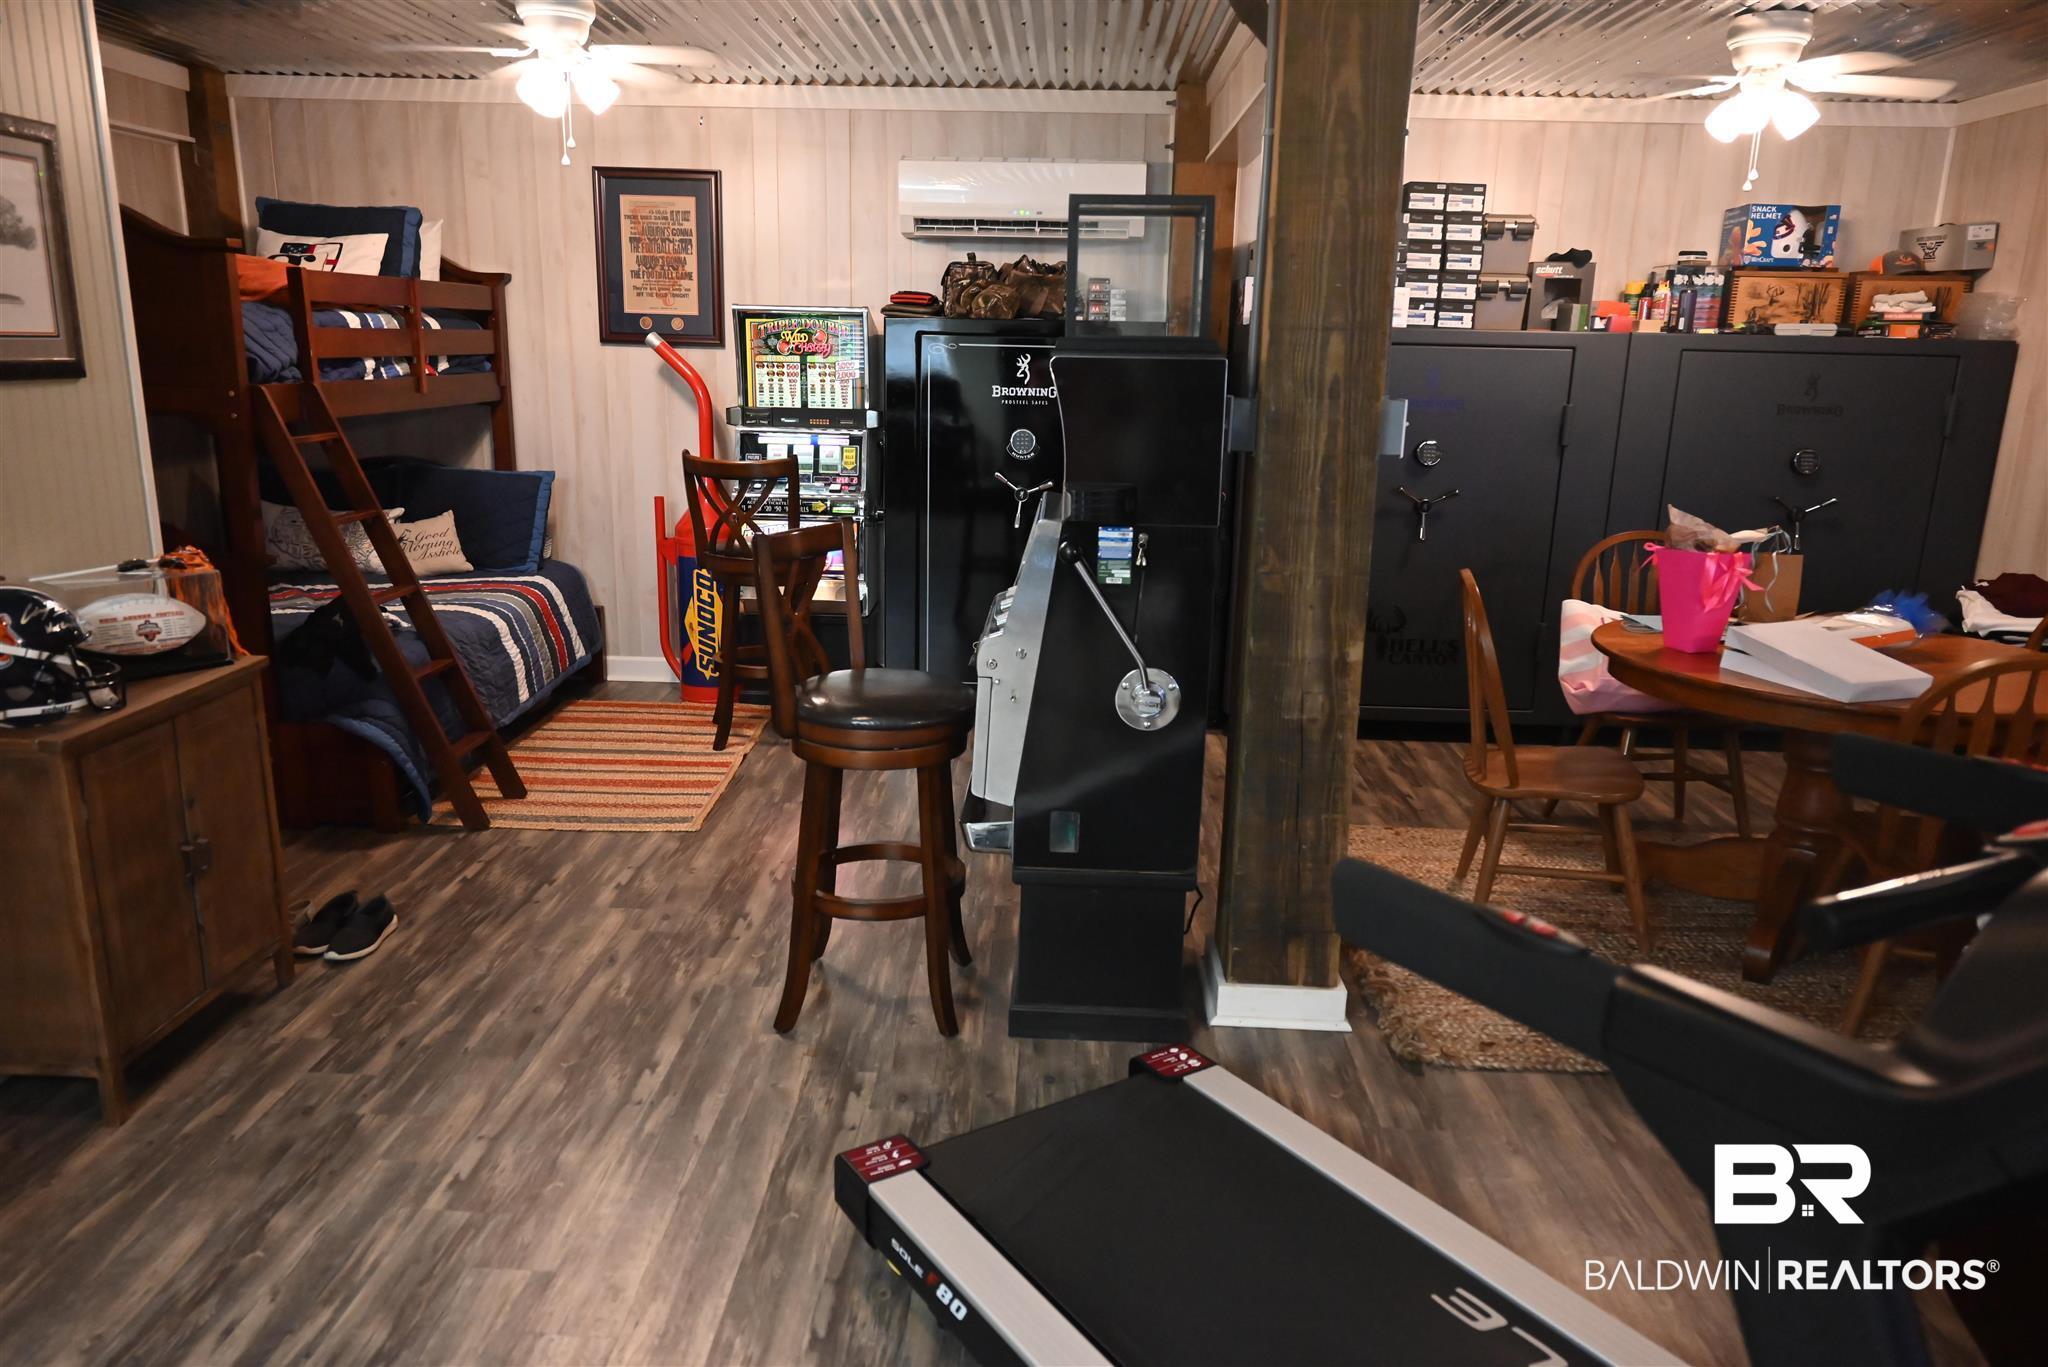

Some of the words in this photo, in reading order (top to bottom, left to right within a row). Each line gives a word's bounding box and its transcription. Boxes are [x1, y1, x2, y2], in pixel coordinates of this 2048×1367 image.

[1751, 205, 1777, 213] SNACK
[1535, 264, 1563, 274] schutt
[758, 317, 799, 339] TRIPLE
[991, 385, 1057, 398] BROWNING
[415, 527, 450, 544] Good
[402, 539, 454, 553] Morning
[695, 571, 717, 673] SUNOCO
[890, 1237, 924, 1279] SOLE
